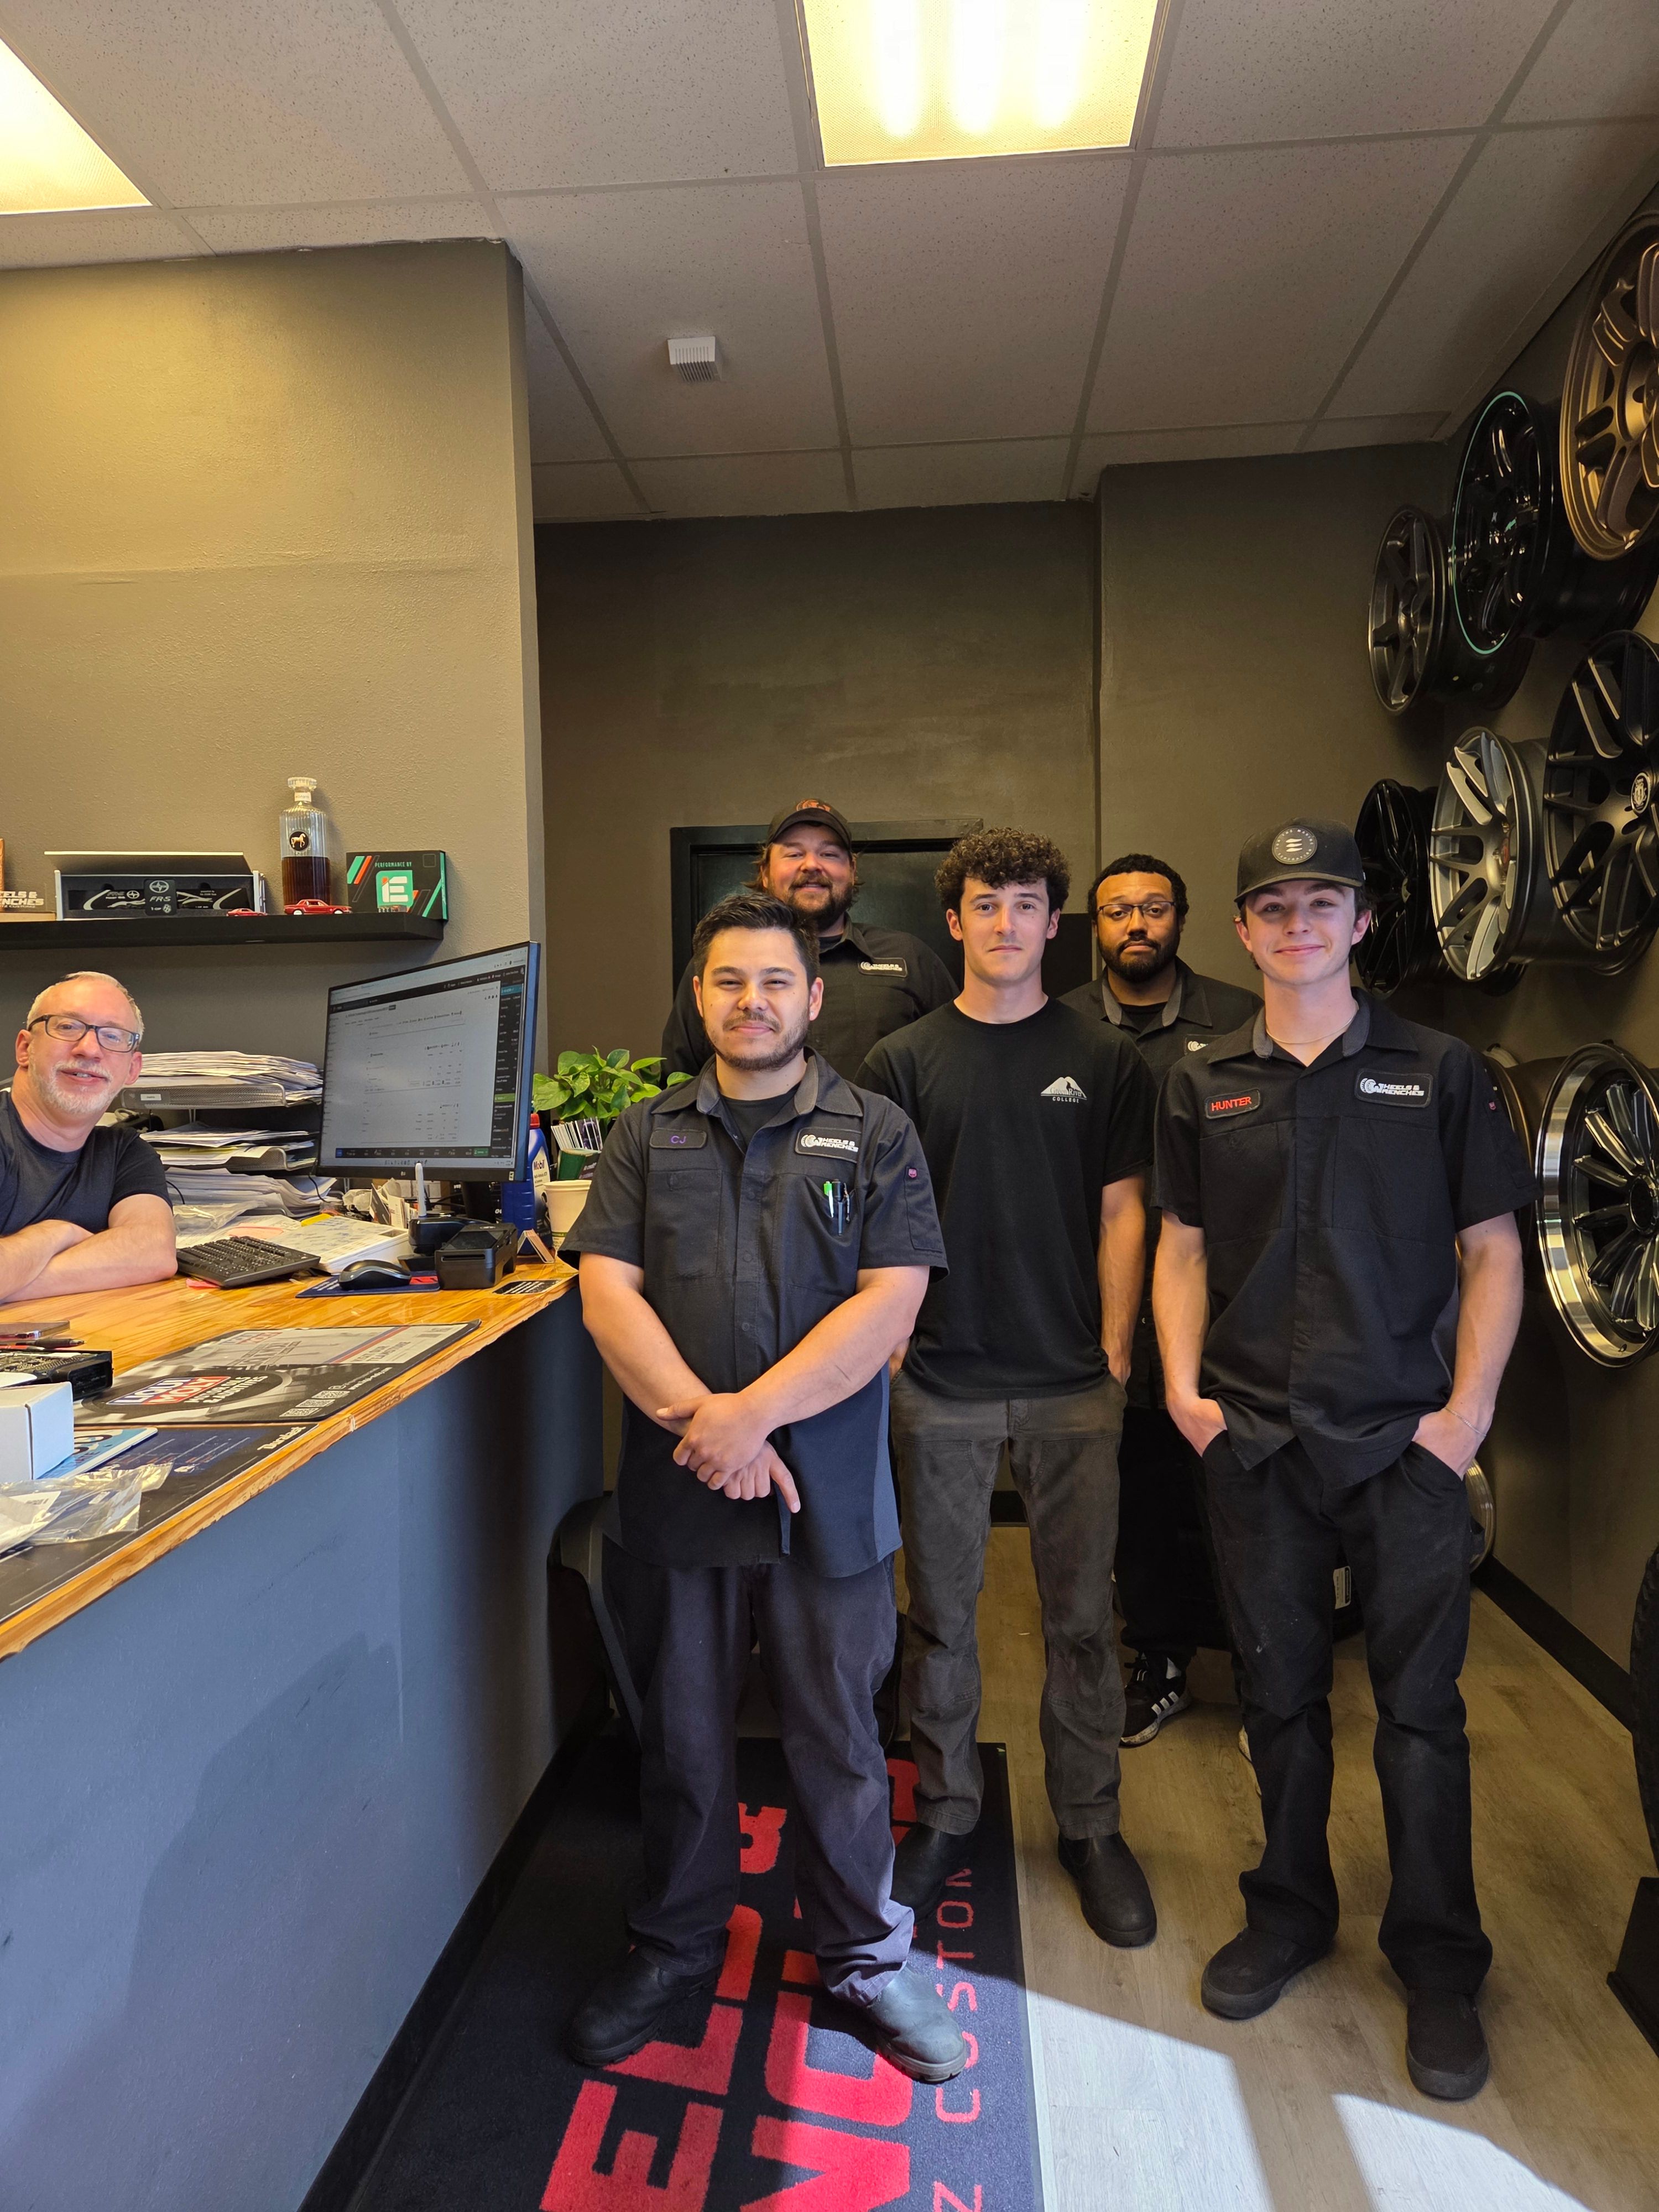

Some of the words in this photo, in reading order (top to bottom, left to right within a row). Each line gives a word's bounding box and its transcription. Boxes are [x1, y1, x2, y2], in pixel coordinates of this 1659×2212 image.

[1211, 1097, 1252, 1112] HUNTER
[671, 1135, 687, 1144] CJ
[148, 1378, 222, 1404] MOLY
